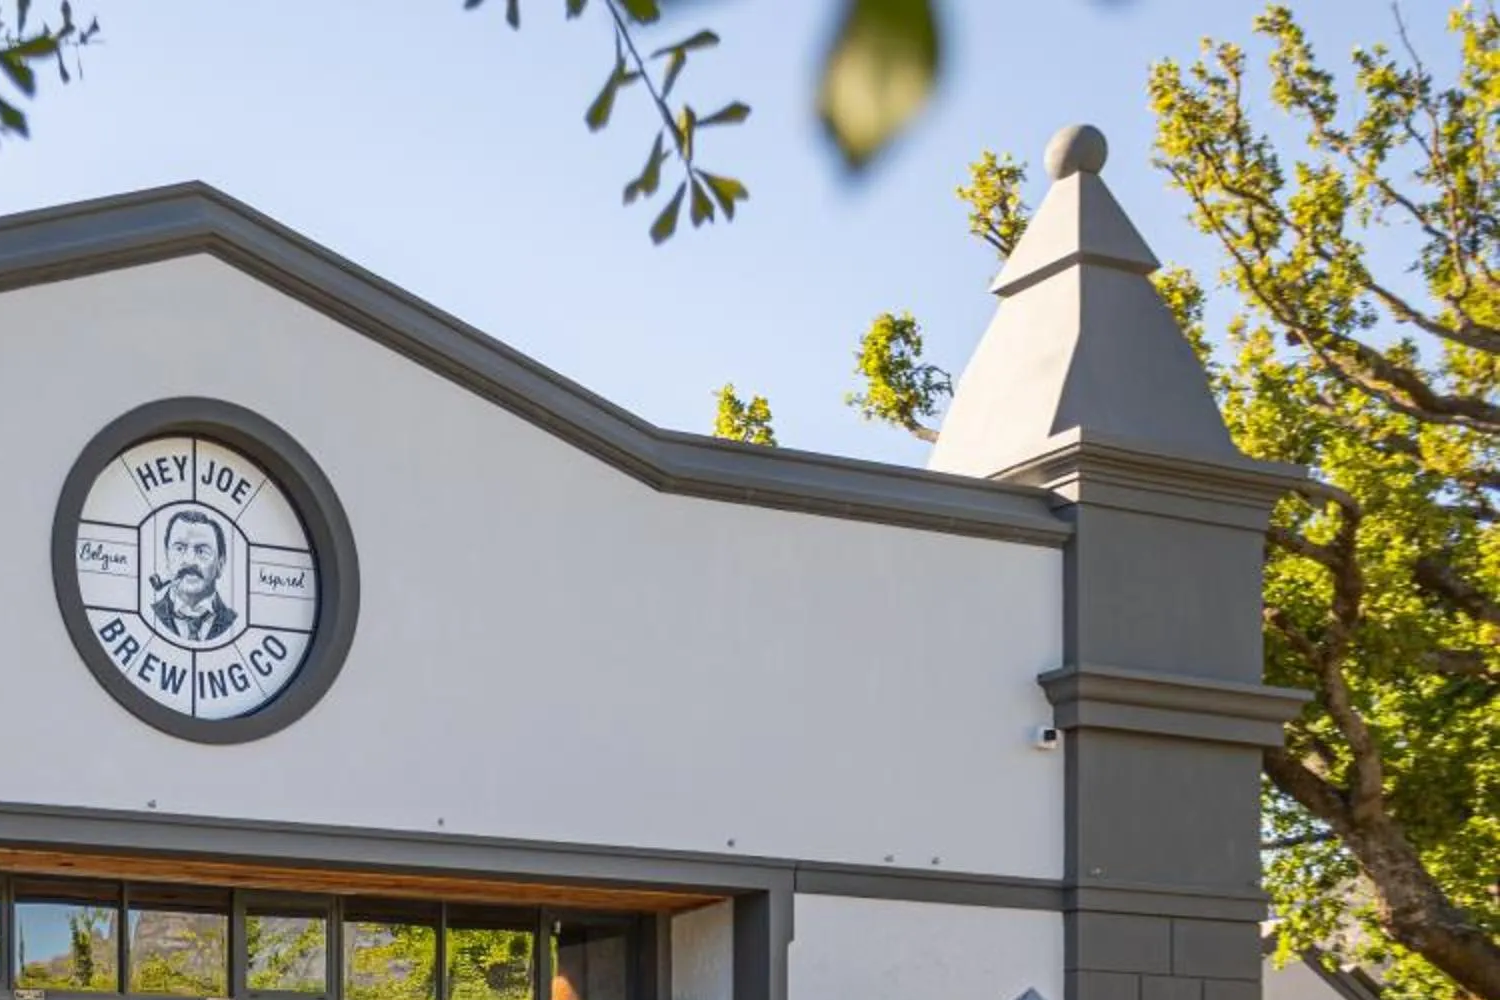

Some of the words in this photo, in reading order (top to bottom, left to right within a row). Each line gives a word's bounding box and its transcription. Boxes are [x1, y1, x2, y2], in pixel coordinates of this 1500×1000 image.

[135, 455, 188, 491] HEY
[201, 460, 251, 504] JOE
[80, 542, 128, 571] Belgian
[99, 617, 251, 699] BREWING
[250, 635, 287, 677] CO
